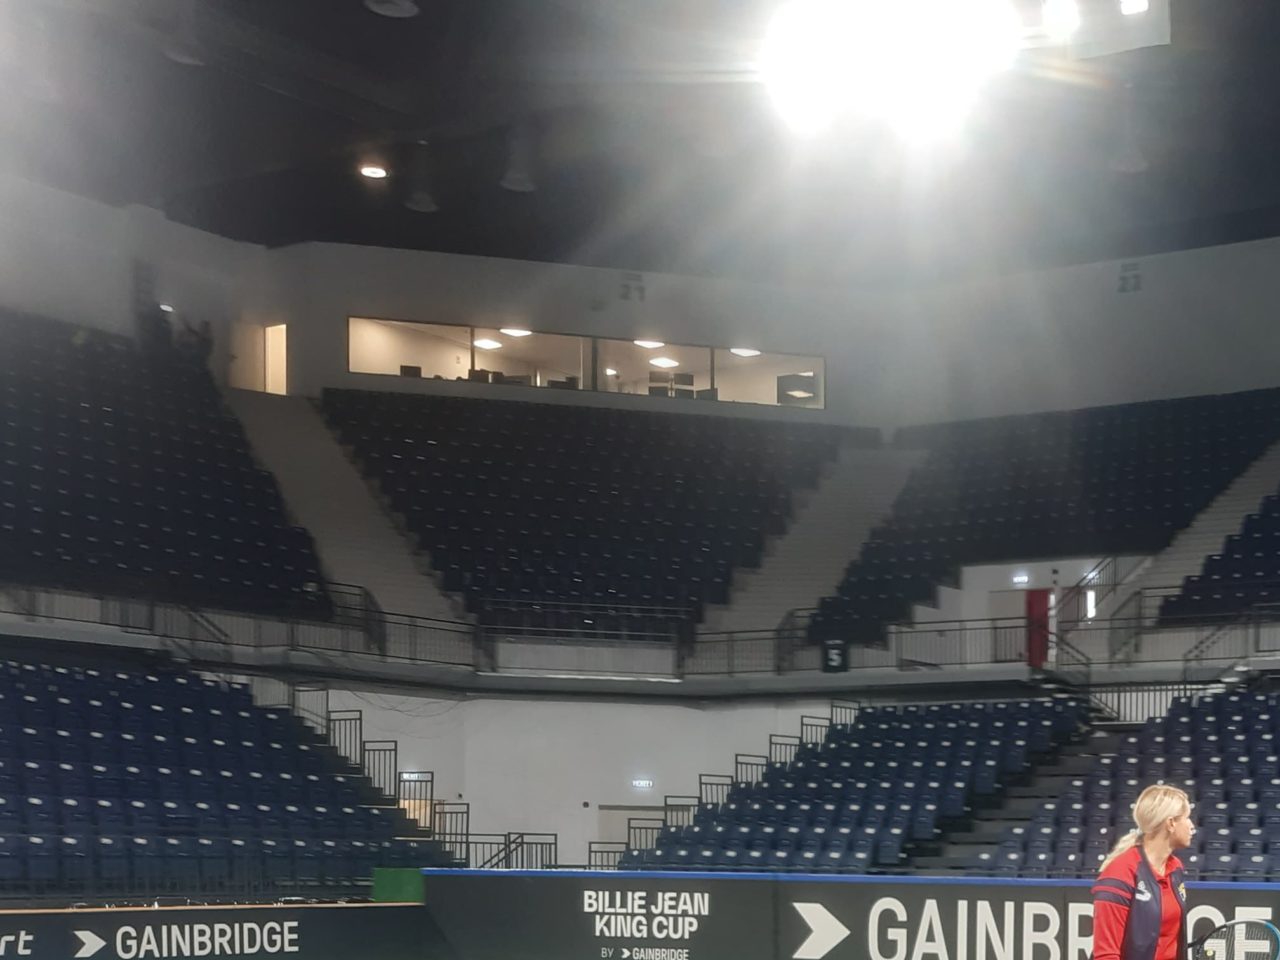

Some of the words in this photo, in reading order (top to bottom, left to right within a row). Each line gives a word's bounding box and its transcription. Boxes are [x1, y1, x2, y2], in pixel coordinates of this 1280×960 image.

[827, 649, 842, 666] 5
[583, 890, 647, 913] BILLIE
[650, 892, 709, 915] JEAN
[595, 915, 648, 938] KING
[652, 917, 698, 939] CUP
[115, 920, 300, 960] GAINBRIDGE
[601, 947, 614, 958] BY
